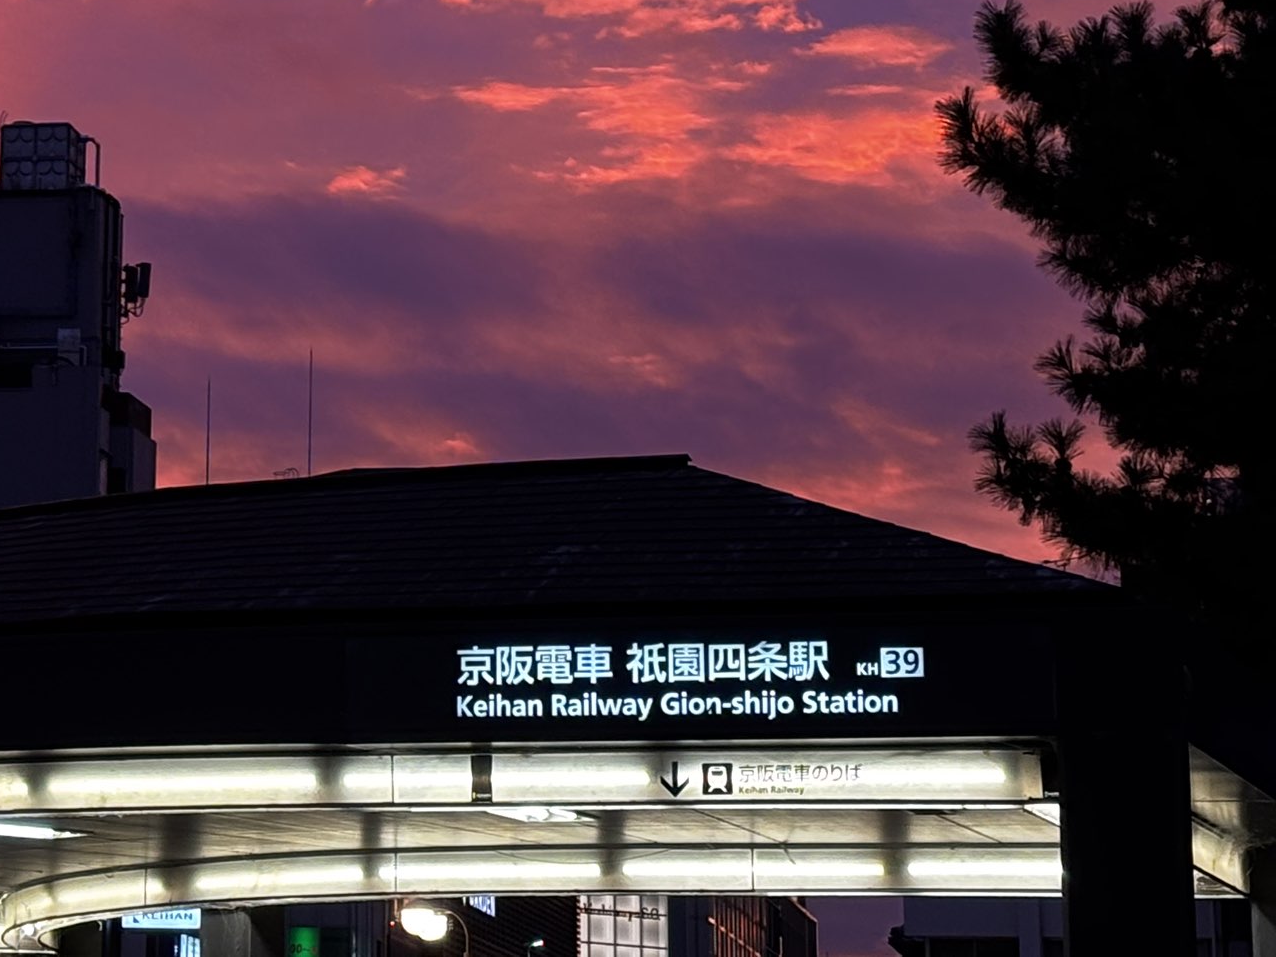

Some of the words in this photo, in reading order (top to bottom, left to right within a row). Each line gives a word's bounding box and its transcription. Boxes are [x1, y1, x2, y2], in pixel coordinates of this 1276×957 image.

[457, 644, 613, 685] 京阪電車
[626, 641, 829, 683] 祇園四条駅
[856, 662, 879, 676] KH
[884, 649, 920, 675] 39
[456, 693, 543, 717] Keihan
[551, 692, 653, 721] Railway
[660, 690, 794, 720] Gion-shijo
[802, 689, 899, 714] Station
[739, 764, 862, 783] 京阪電車のりば
[739, 786, 768, 794] Keihan
[771, 786, 804, 795] Railway
